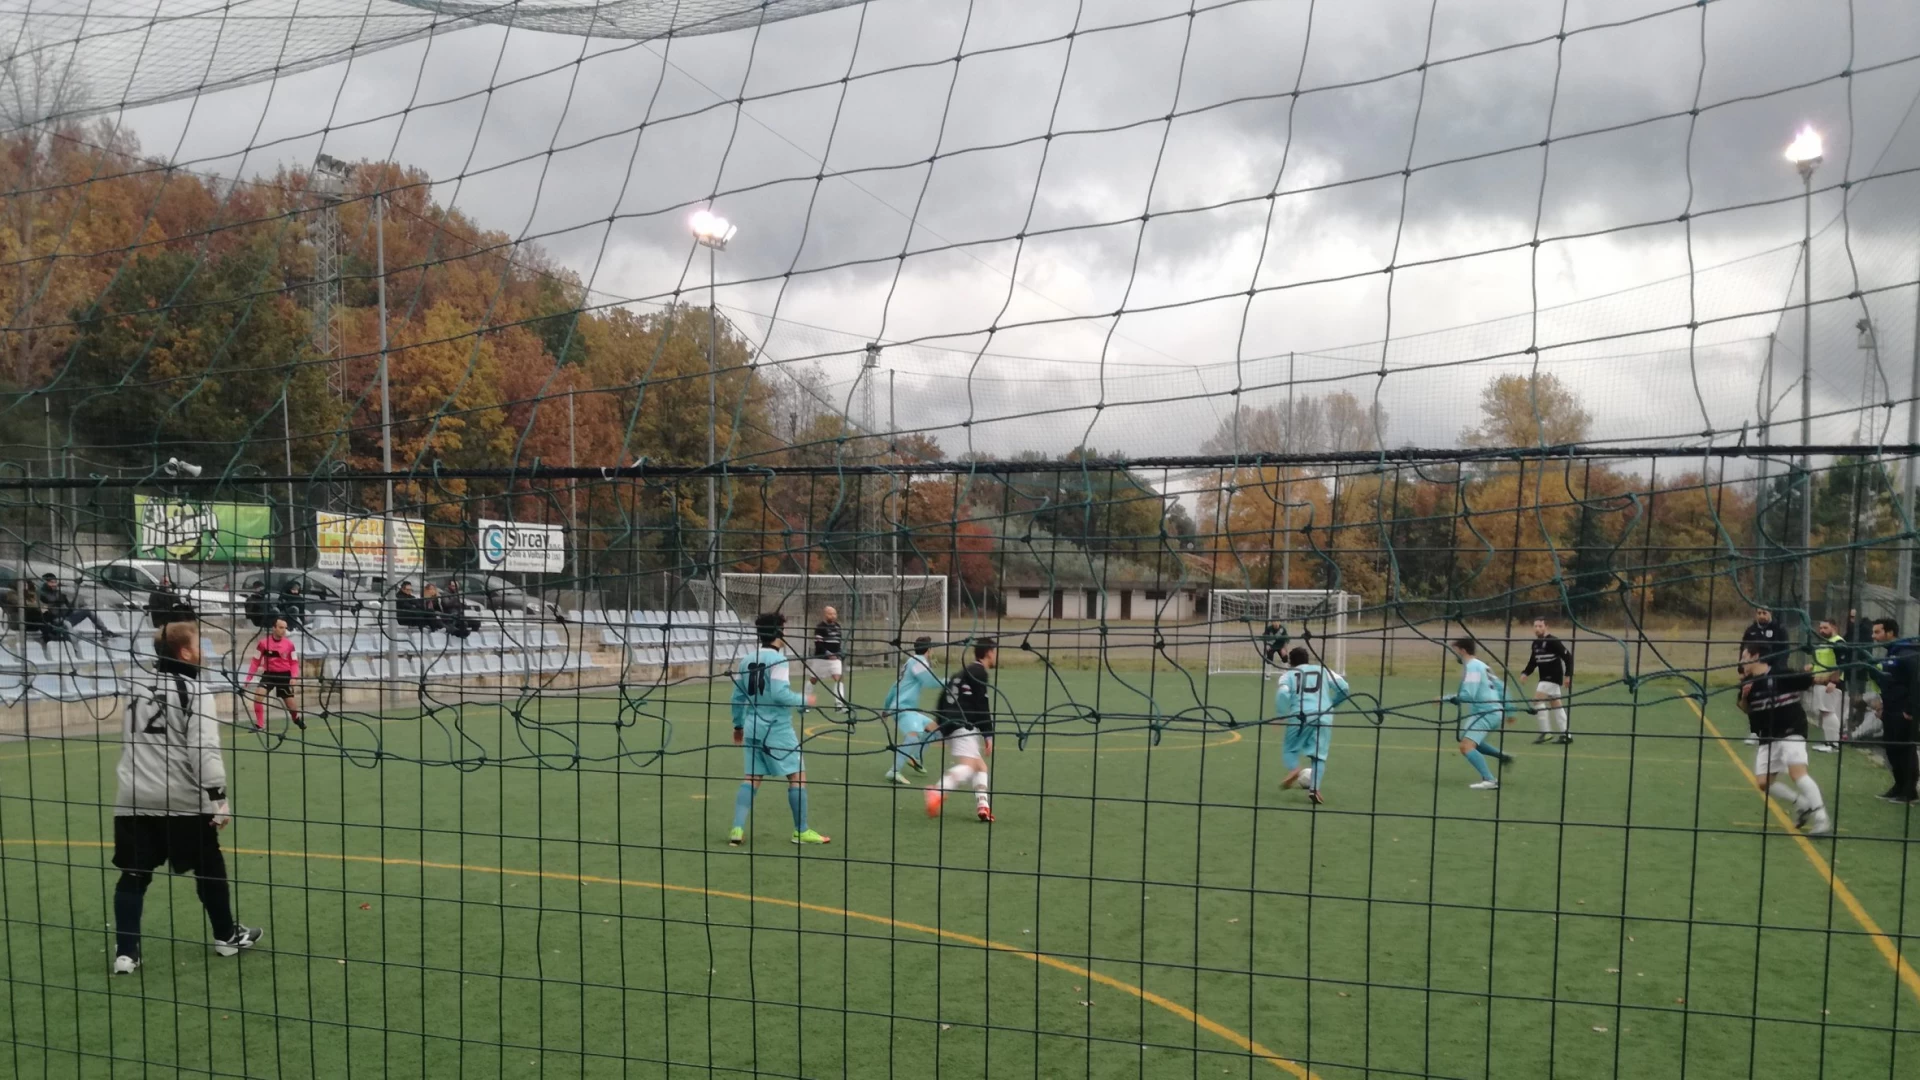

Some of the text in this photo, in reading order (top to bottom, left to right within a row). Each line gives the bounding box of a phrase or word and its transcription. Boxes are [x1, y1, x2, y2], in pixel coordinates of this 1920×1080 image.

[320, 515, 389, 536] PIZZERI
[1294, 670, 1321, 695] 10
[127, 694, 167, 734] 12
